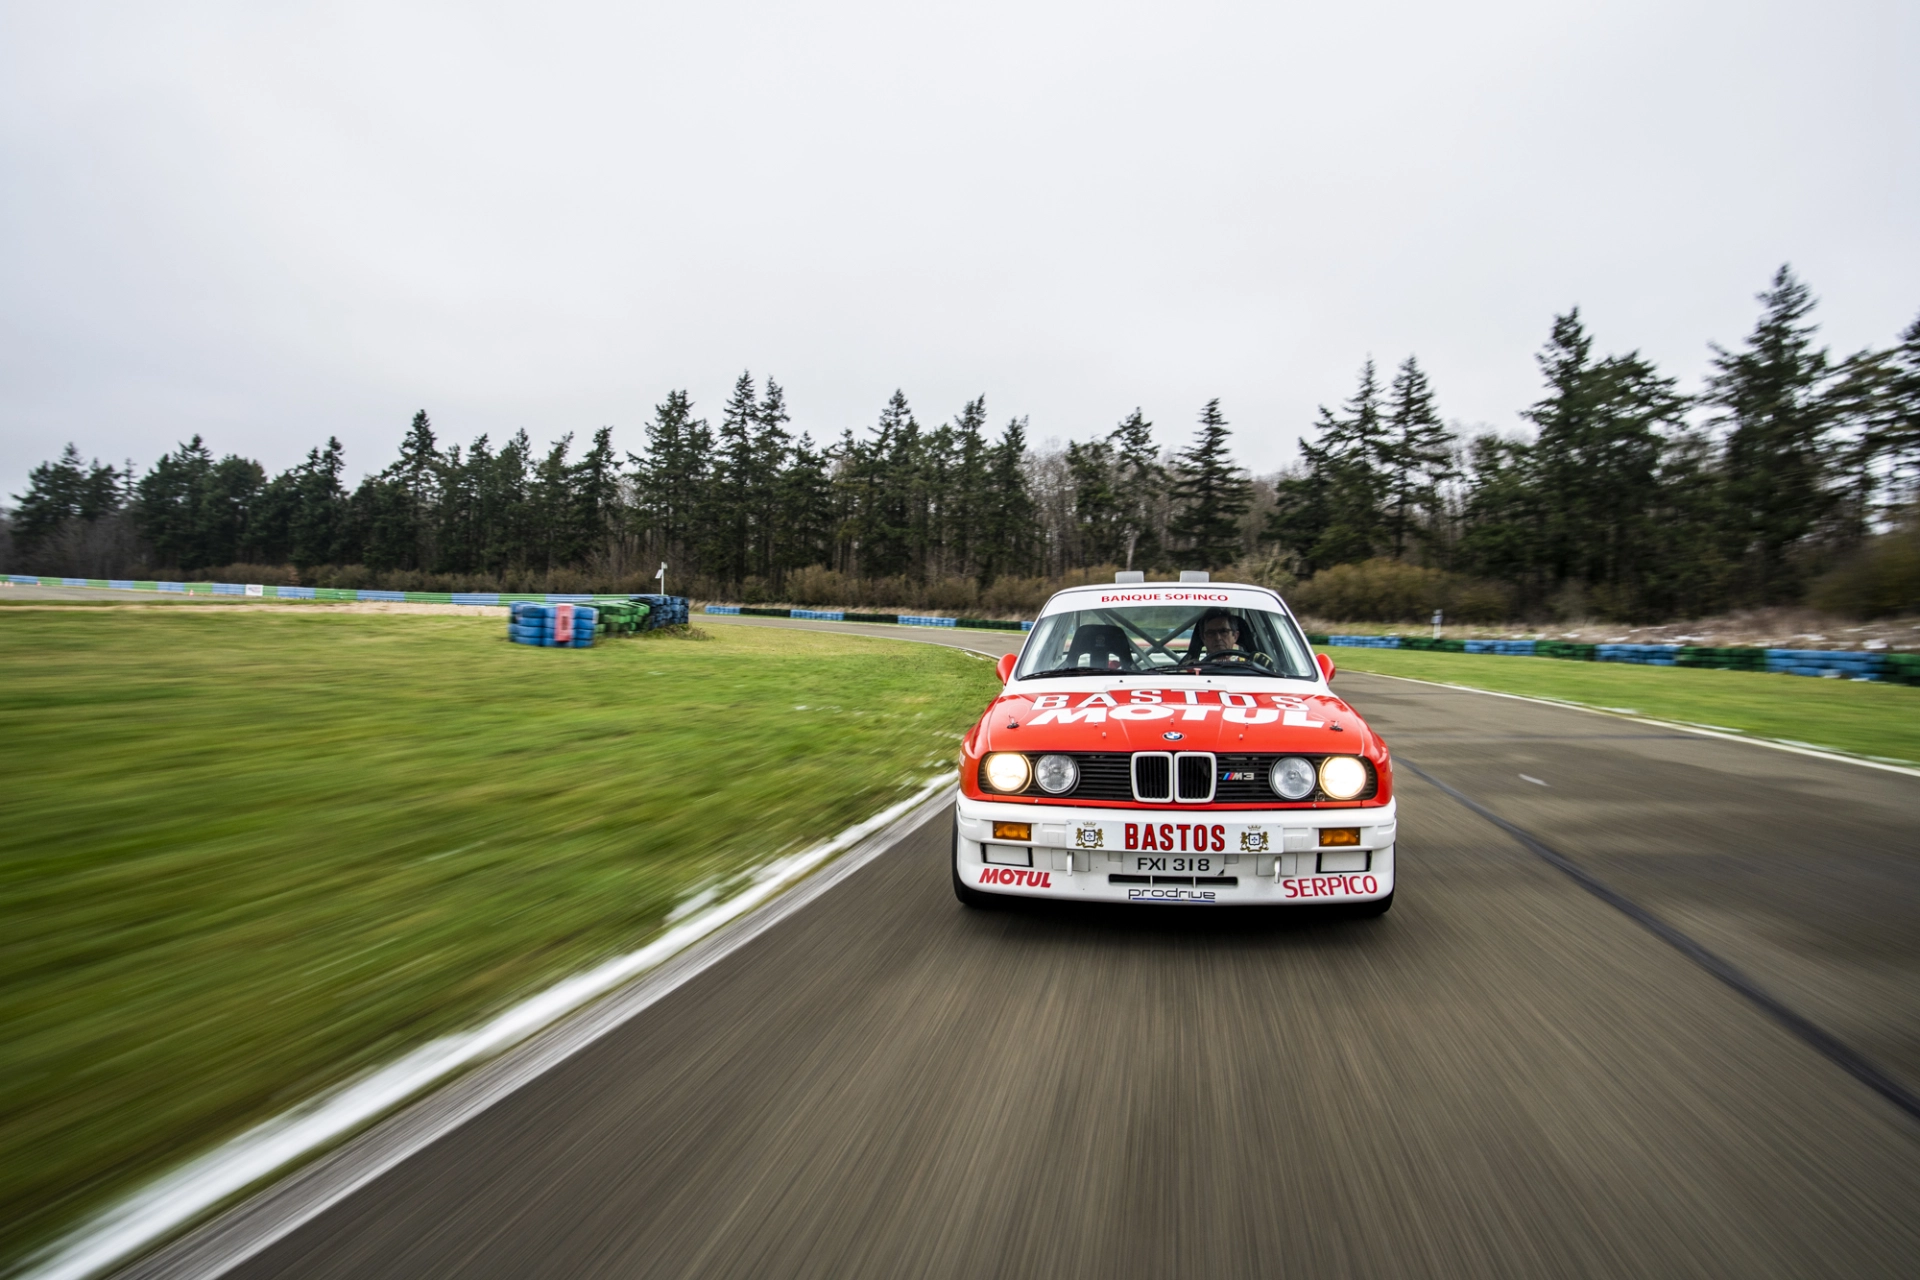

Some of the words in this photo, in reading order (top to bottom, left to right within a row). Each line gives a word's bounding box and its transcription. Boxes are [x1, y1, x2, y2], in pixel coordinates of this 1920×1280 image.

[1101, 594, 1162, 603] BANQUE
[1165, 593, 1229, 602] SOFINCO
[1031, 689, 1310, 711] BASTOS
[1026, 704, 1326, 728] MOTUL
[1230, 772, 1255, 781] M3
[1124, 823, 1226, 852] BASTOS
[1137, 857, 1166, 871] FXI
[1172, 858, 1211, 872] 318
[979, 868, 1052, 889] MOTUL
[1282, 875, 1378, 899] SERPICO
[1128, 887, 1216, 900] prodrive
